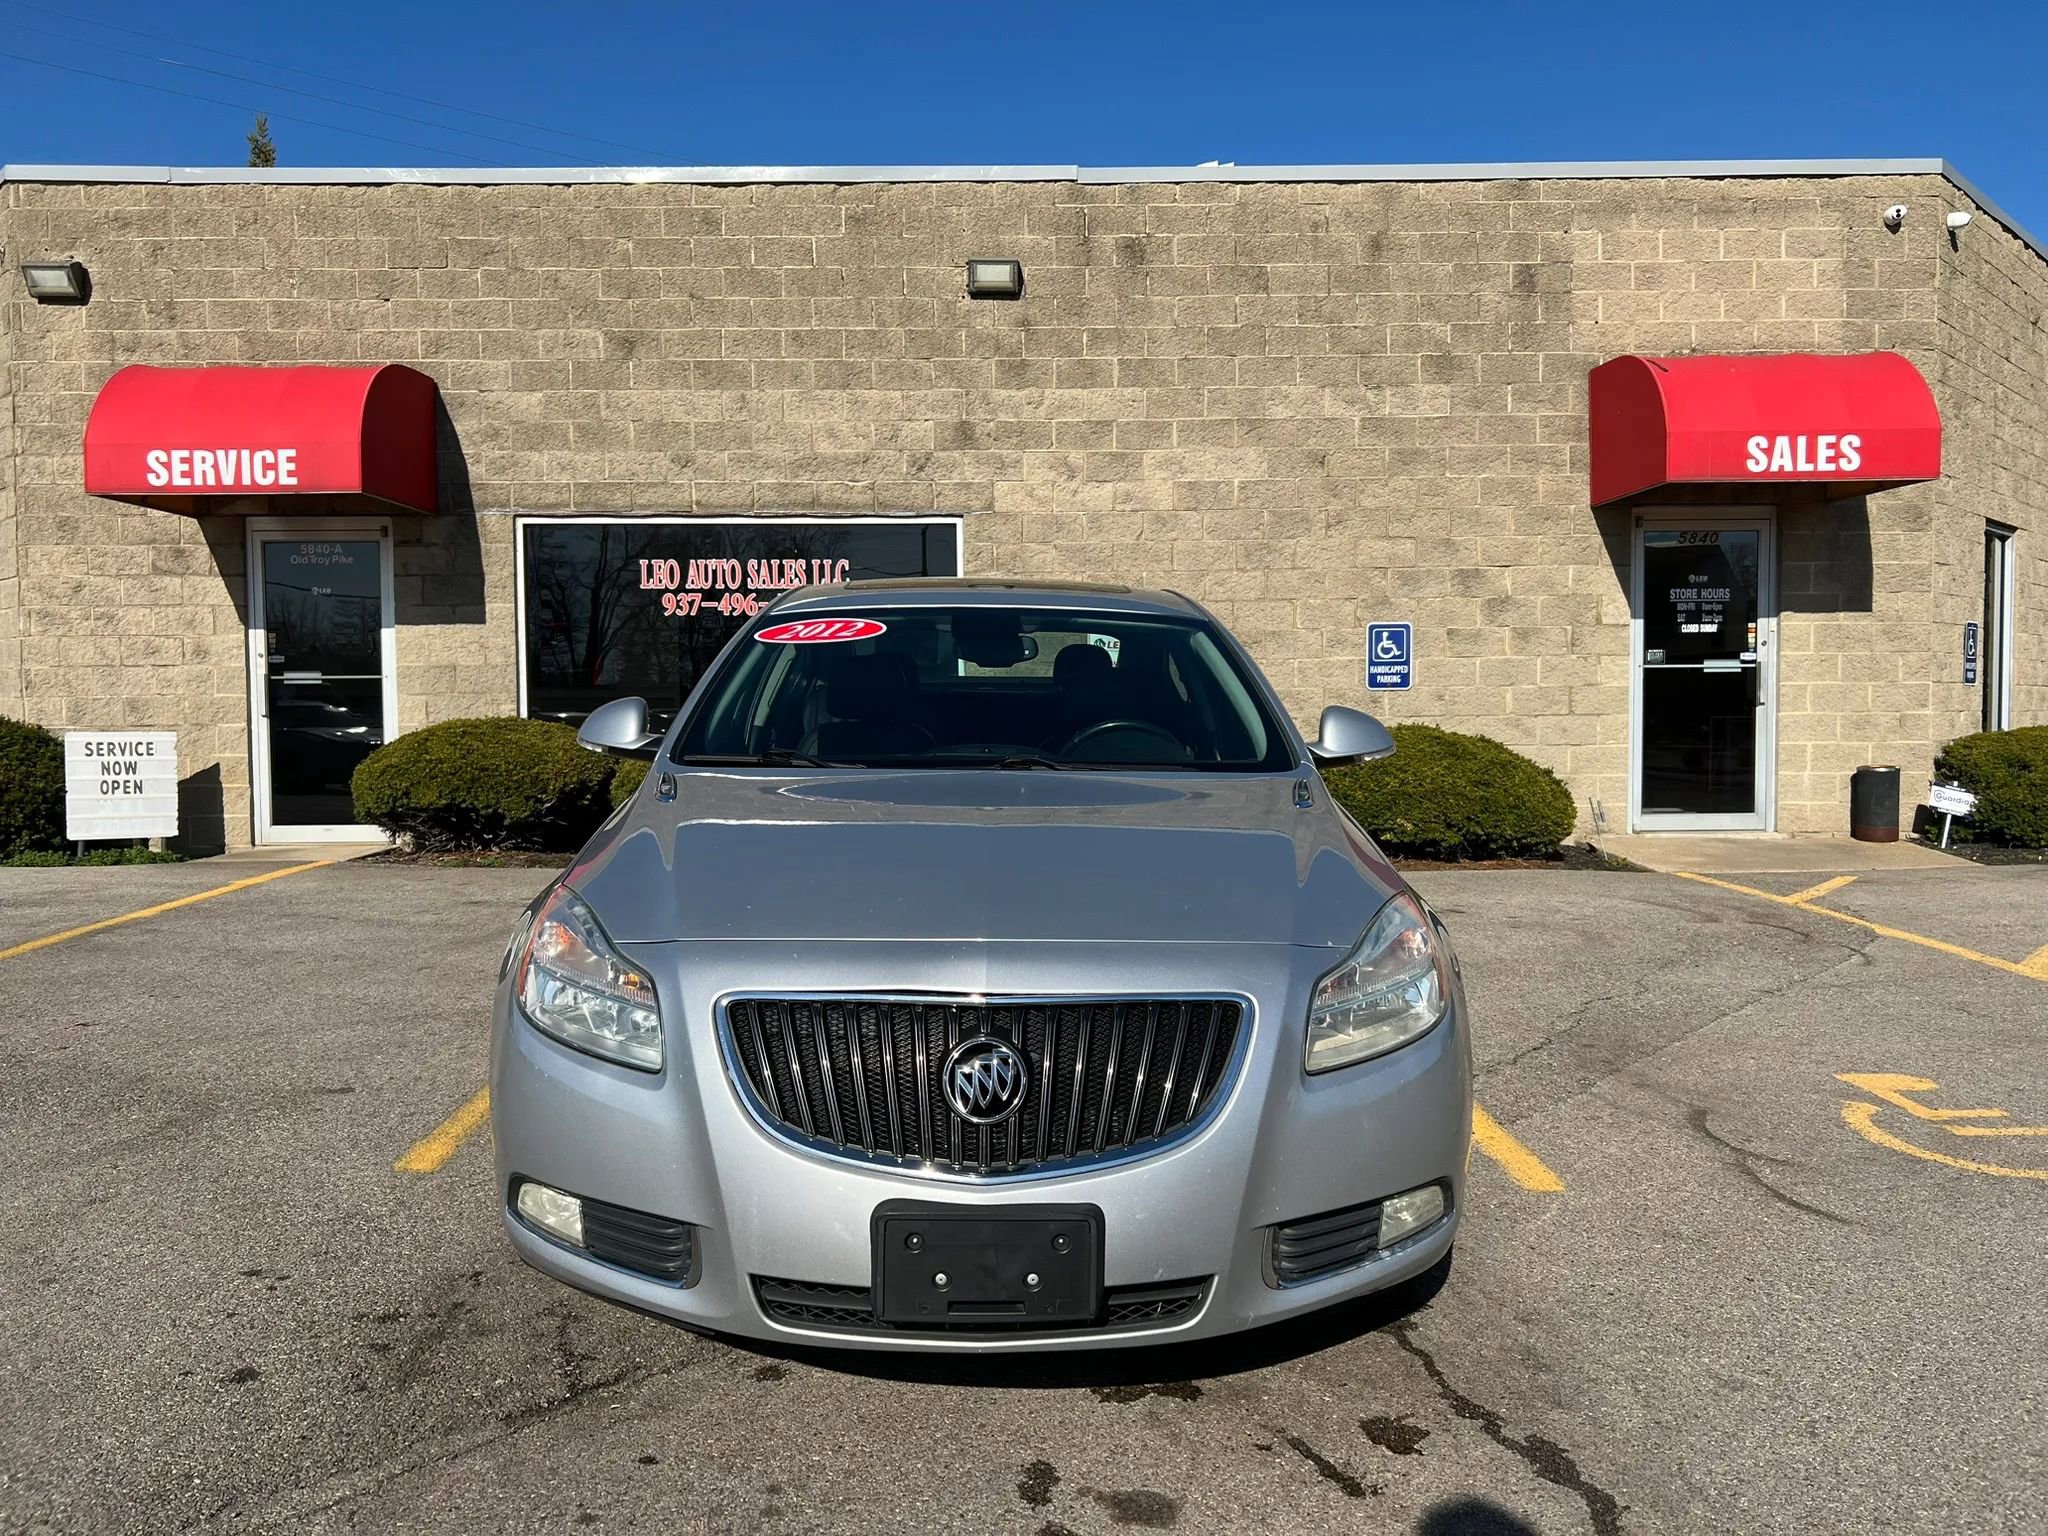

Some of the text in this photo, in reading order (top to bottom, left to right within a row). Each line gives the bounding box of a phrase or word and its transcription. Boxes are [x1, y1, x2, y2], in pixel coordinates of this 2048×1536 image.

[1746, 434, 1861, 473] SALES
[146, 448, 298, 487] SERVICE
[1678, 532, 1719, 544] 5840
[300, 543, 343, 554] 5840-A
[290, 554, 354, 566] Old Troy Pike
[640, 558, 850, 590] LEO AUTO SALES LLC
[1670, 588, 1730, 599] STORE HOURS
[776, 620, 865, 640] 2012
[1681, 623, 1718, 633] CLOSED SUNDAY
[1370, 665, 1409, 674] HANDICAPPED
[1377, 675, 1402, 684] PARKING
[84, 741, 154, 757] SERVICE
[101, 760, 138, 776] NOW
[100, 780, 143, 795] OPEN
